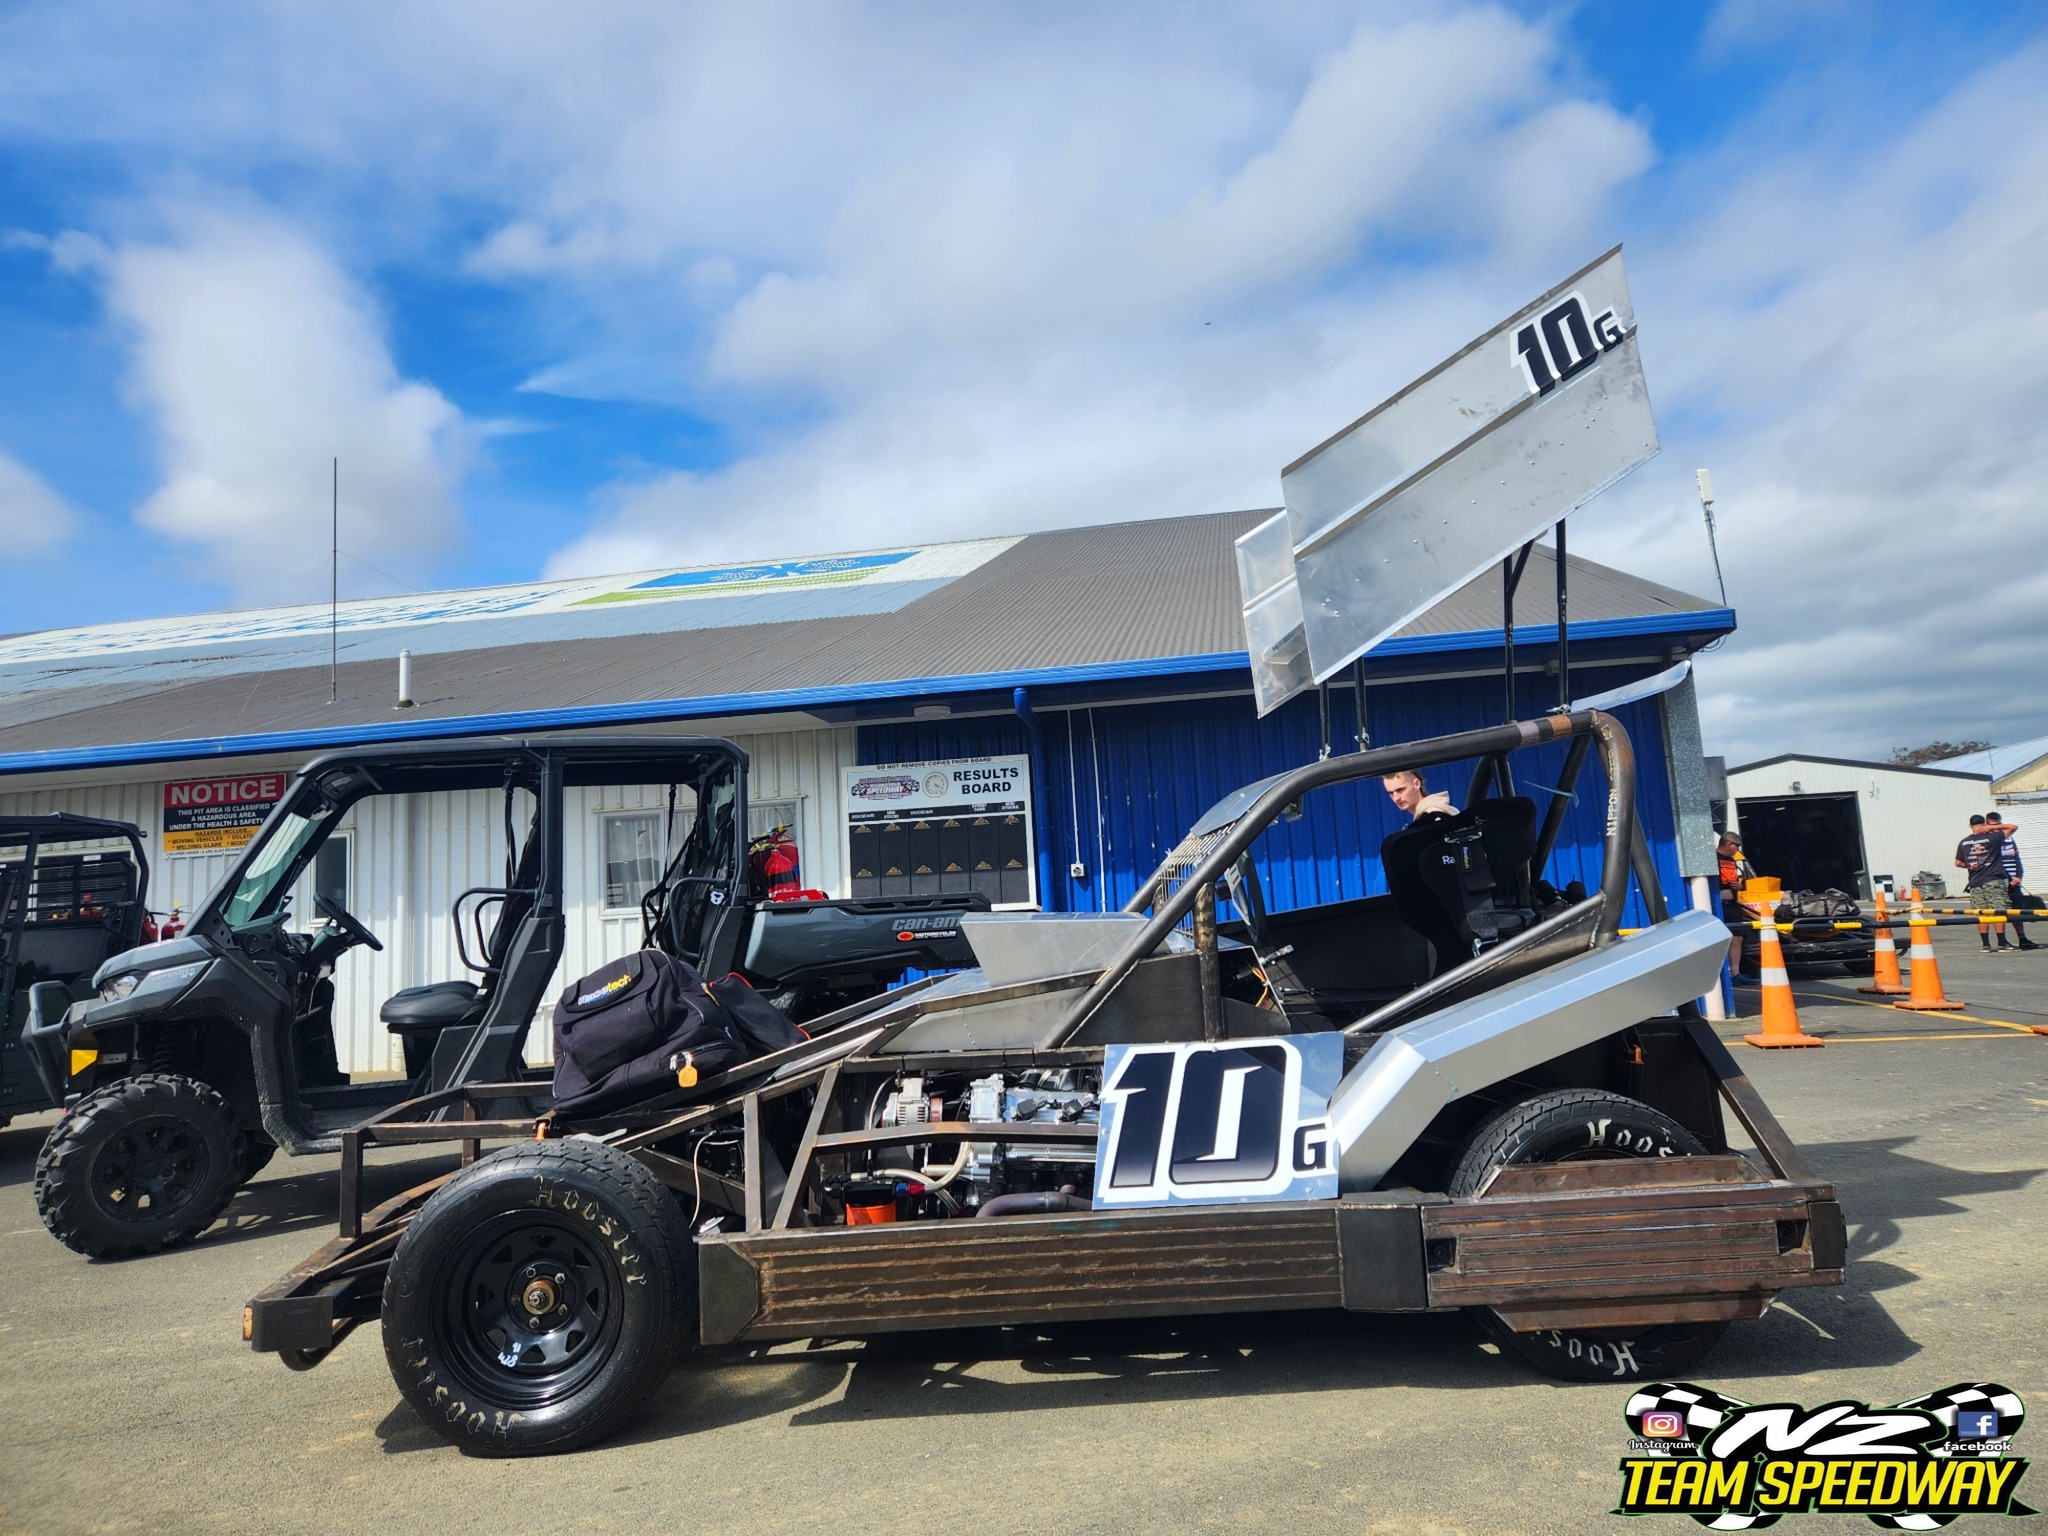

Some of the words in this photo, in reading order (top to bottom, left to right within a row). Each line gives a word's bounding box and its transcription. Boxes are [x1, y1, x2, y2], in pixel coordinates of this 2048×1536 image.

[953, 767, 1019, 782] RESULTS
[171, 779, 277, 805] NOTICE
[961, 781, 1012, 795] BOARD
[232, 803, 270, 812] CLASSIFIED
[1606, 788, 1618, 837] NIPPON
[197, 813, 238, 821] HAZARDOUS
[207, 820, 232, 828] HEALTH
[239, 818, 264, 826] SAFETY
[196, 835, 223, 843] VEHICLES
[892, 917, 961, 931] can-am
